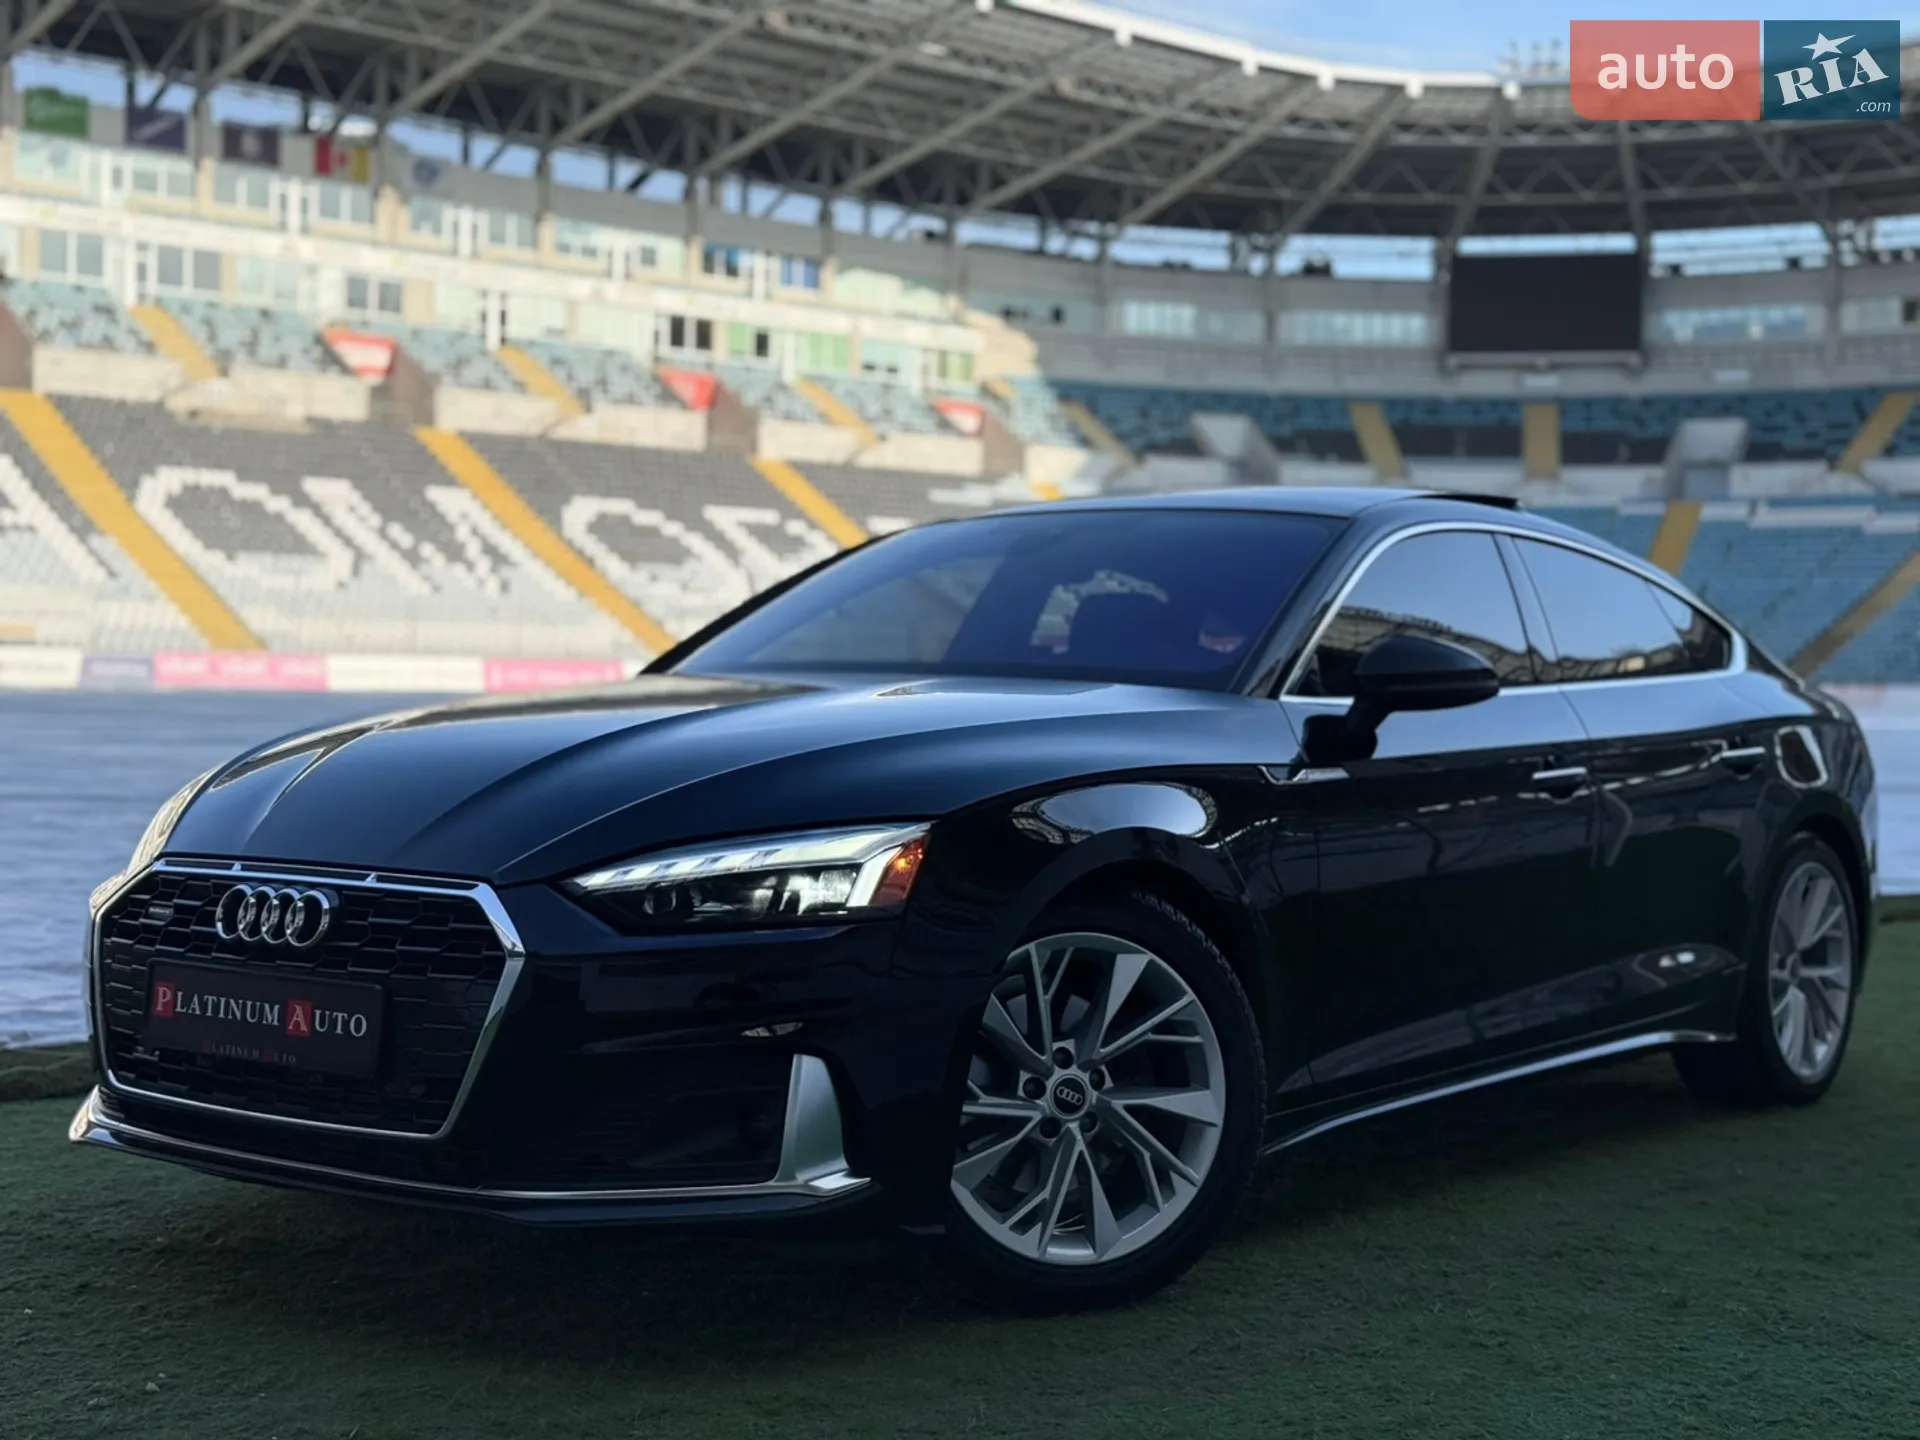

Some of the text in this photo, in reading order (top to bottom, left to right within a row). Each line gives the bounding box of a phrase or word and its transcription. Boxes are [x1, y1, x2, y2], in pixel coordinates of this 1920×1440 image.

[155, 985, 368, 1038] PLATINUM AUTO
[202, 1040, 297, 1065] LATINUM UTO
